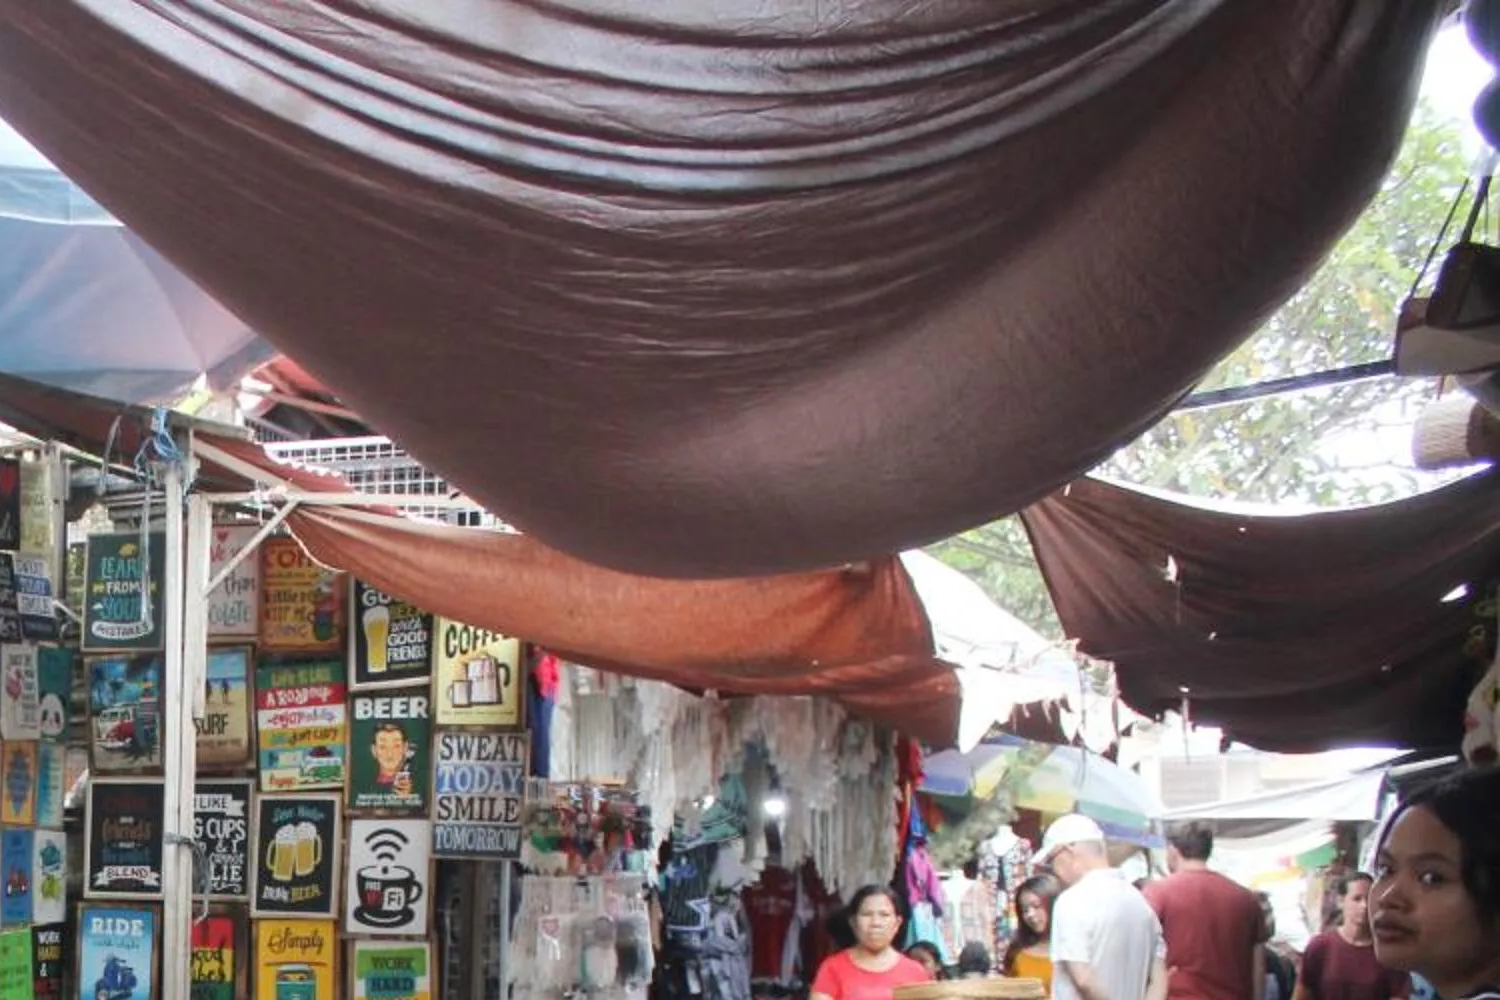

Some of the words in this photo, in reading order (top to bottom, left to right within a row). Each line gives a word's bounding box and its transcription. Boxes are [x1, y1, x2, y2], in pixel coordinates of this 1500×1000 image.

[388, 631, 427, 646] GOOD
[387, 646, 427, 662] FRIENDS
[355, 697, 428, 719] BEER
[440, 735, 522, 762] SWEAT
[439, 764, 522, 792] TODAY
[437, 796, 519, 822] SMILE
[206, 816, 245, 841] CUPS
[435, 825, 520, 851] TOMORROW
[106, 866, 149, 878] BLEND
[211, 858, 243, 882] LIE
[91, 917, 144, 936] RIDE
[266, 928, 325, 954] Simply
[371, 956, 414, 970] WORK
[370, 975, 414, 991] HARD
